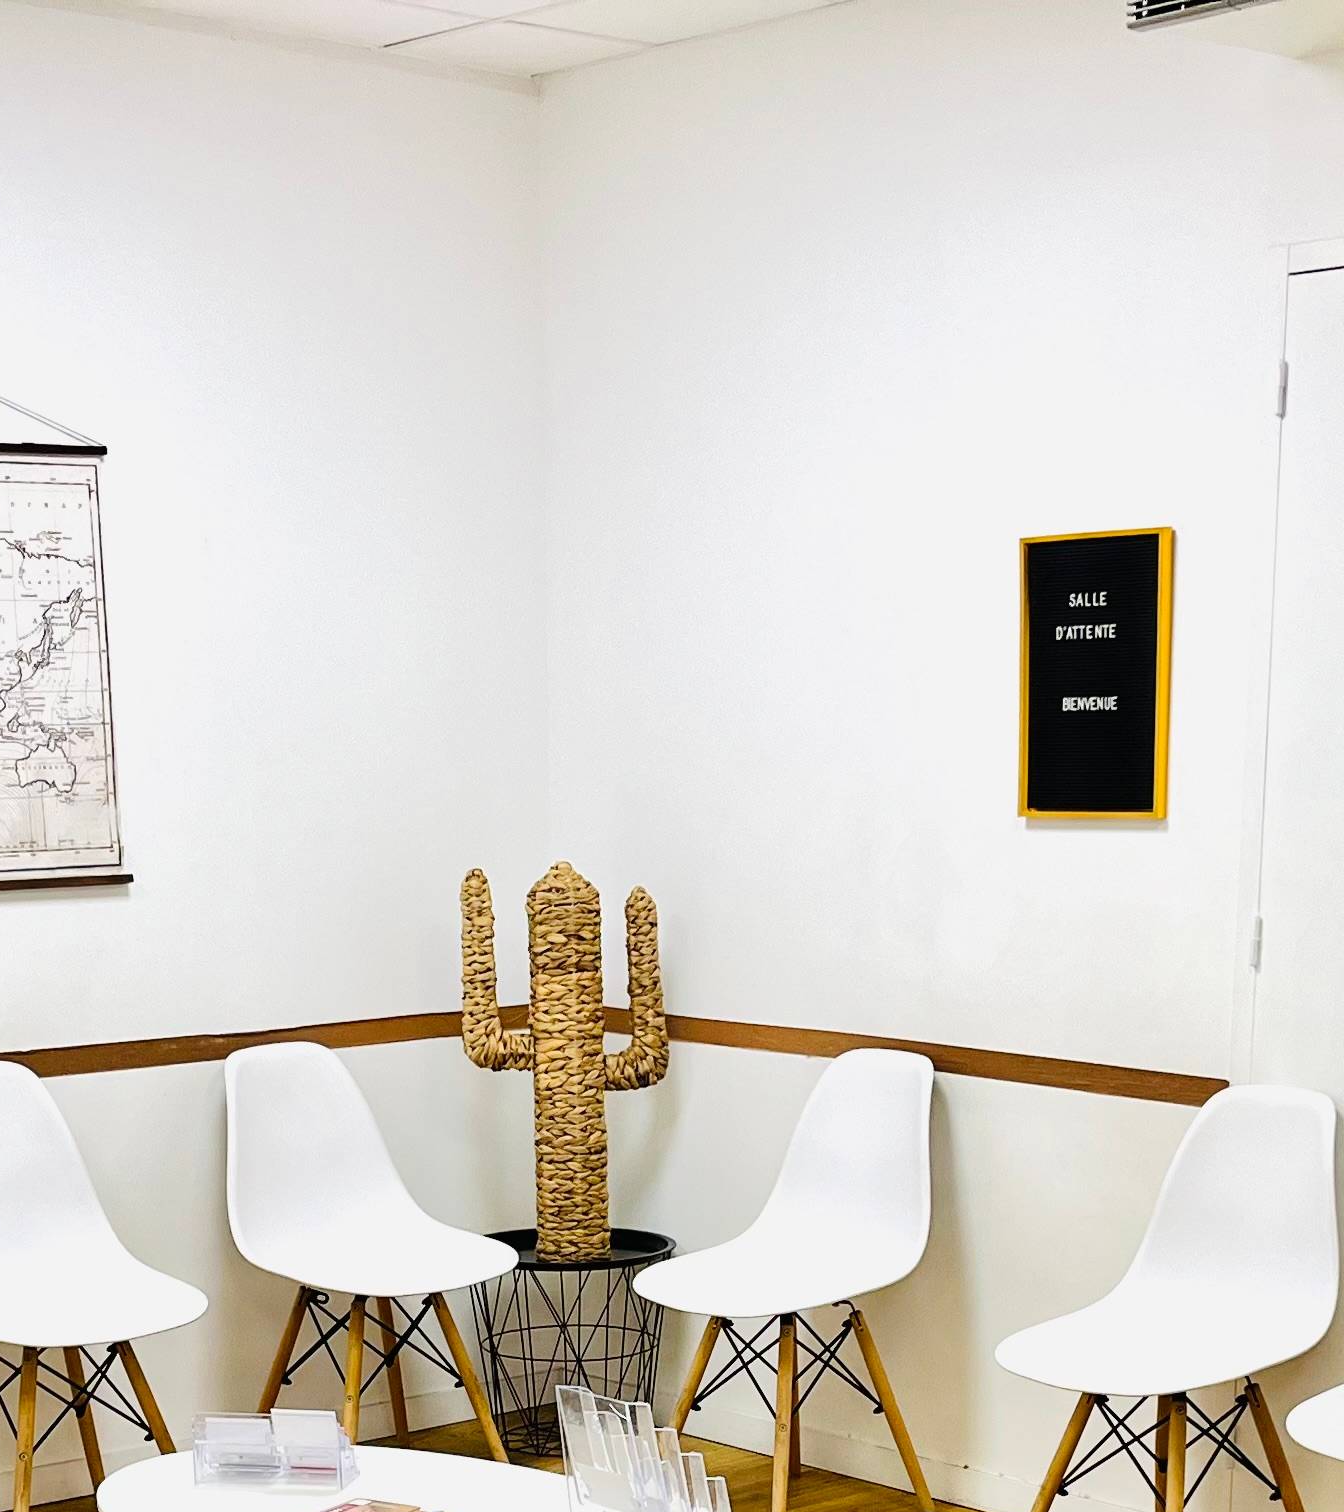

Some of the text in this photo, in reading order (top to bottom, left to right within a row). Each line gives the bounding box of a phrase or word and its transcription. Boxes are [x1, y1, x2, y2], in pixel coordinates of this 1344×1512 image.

[1068, 591, 1108, 608] SALLE
[1055, 623, 1117, 641] D'ATTENTE
[1062, 696, 1119, 712] BIENVENUE
